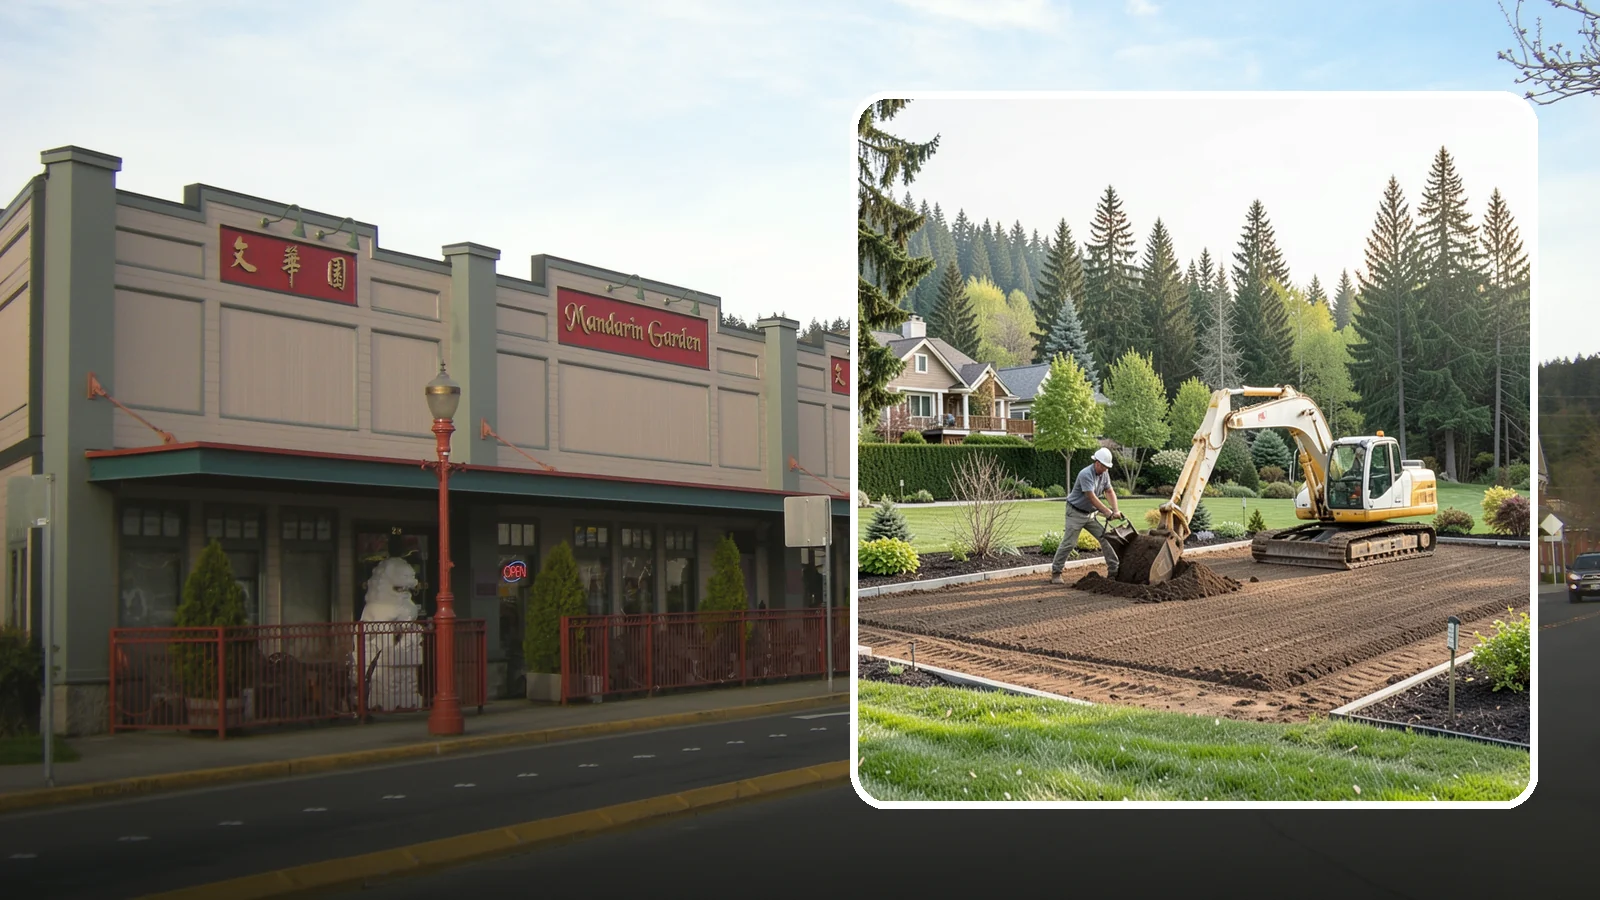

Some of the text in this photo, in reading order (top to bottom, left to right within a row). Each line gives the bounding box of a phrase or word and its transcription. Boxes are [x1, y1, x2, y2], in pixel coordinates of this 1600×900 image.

[230, 235, 346, 291] 文華園
[564, 302, 702, 352] Mandarin Garden
[503, 565, 526, 578] OPEN
